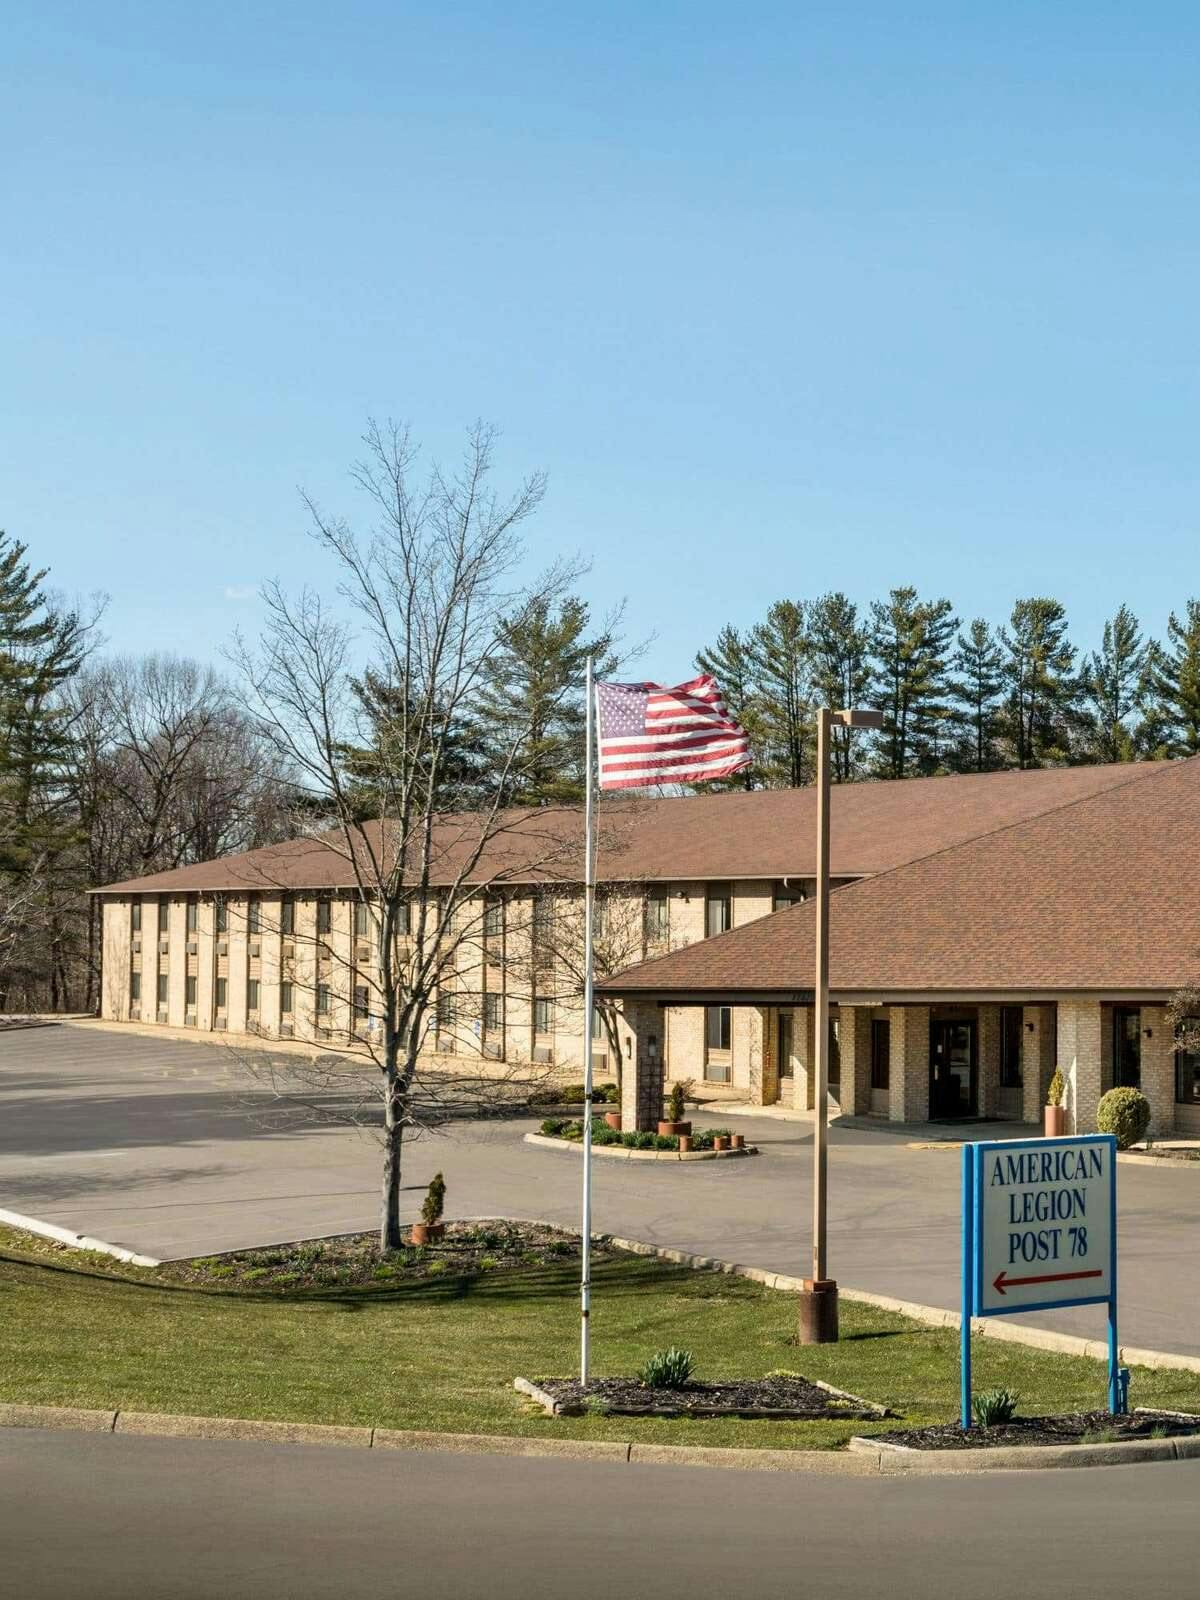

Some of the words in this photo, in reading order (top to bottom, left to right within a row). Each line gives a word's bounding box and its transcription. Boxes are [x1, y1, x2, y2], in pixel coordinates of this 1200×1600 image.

[991, 1148, 1103, 1186] AMERICAN
[1009, 1188, 1087, 1224] LEGION
[1008, 1229, 1062, 1264] POST
[1068, 1227, 1088, 1257] 78
